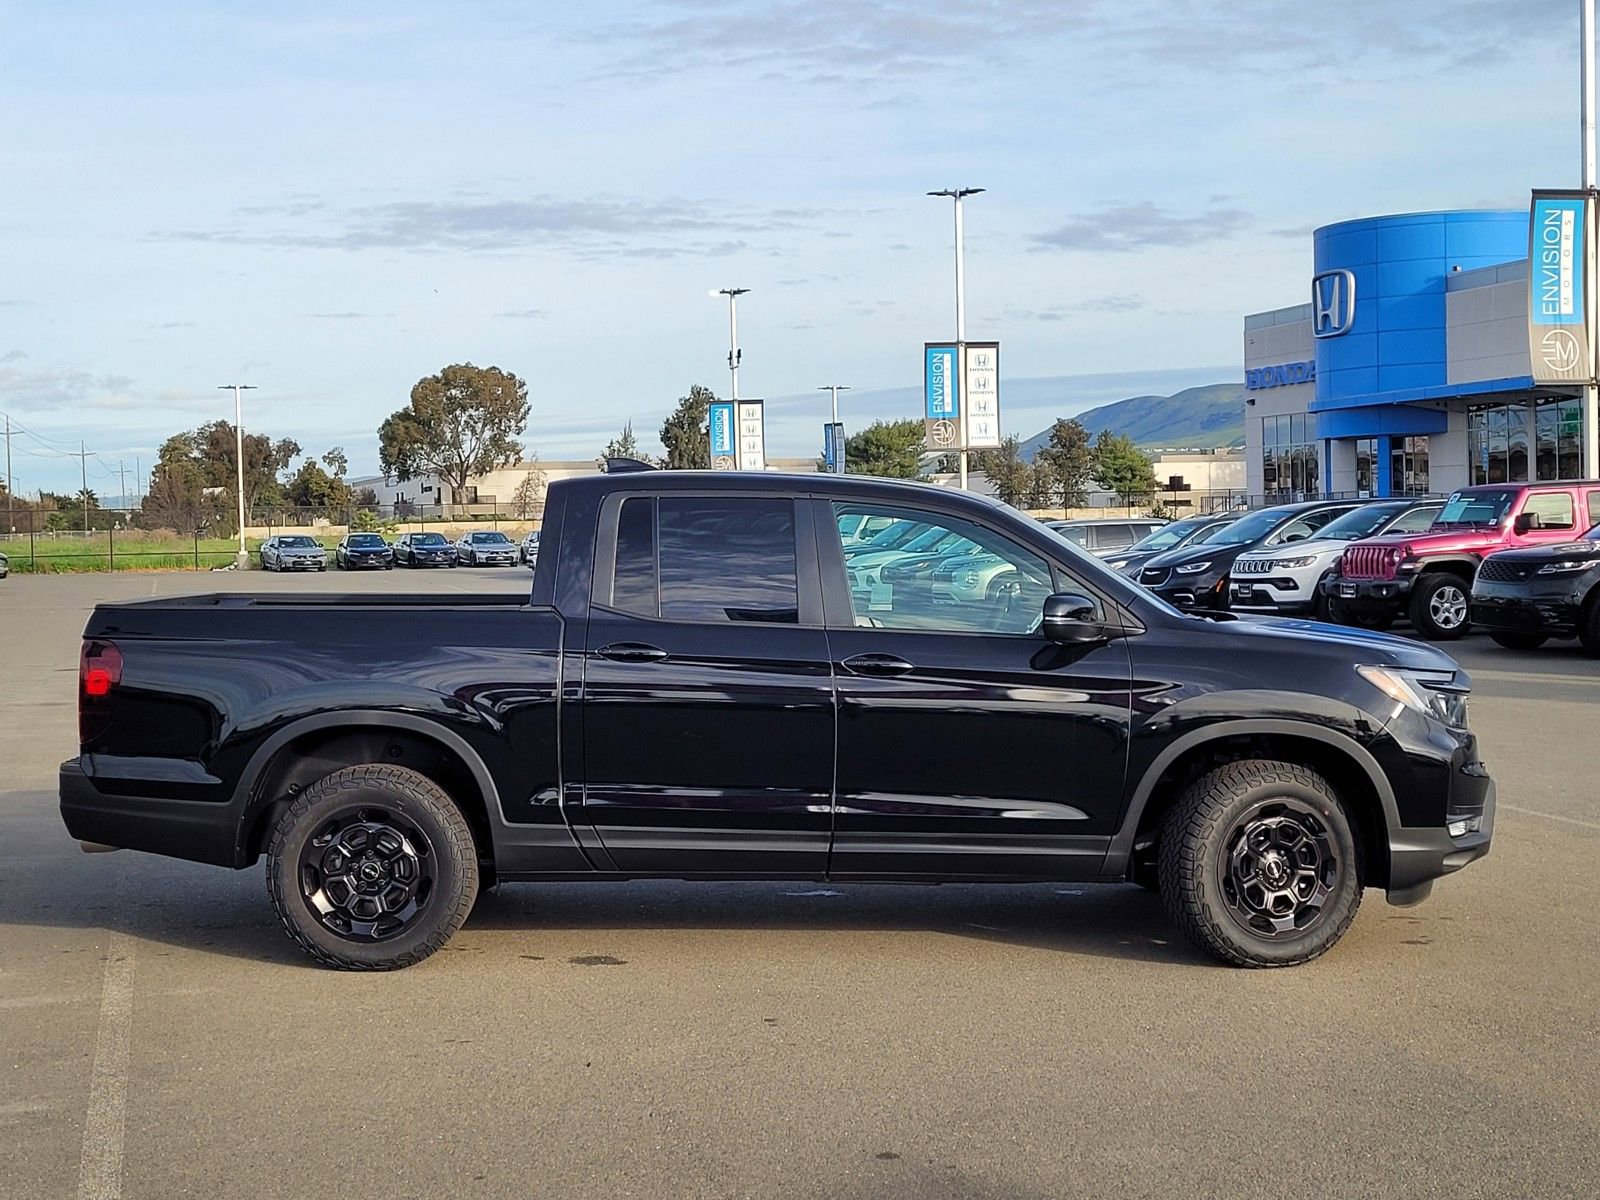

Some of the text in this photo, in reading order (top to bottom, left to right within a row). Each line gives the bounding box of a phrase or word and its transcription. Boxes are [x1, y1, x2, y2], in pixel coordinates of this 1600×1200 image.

[1542, 209, 1562, 315] ENVISION
[1563, 219, 1572, 306] MOTORS
[932, 353, 944, 413] ENVISION
[1246, 360, 1316, 390] HONDA
[714, 408, 724, 451] ENVISION
